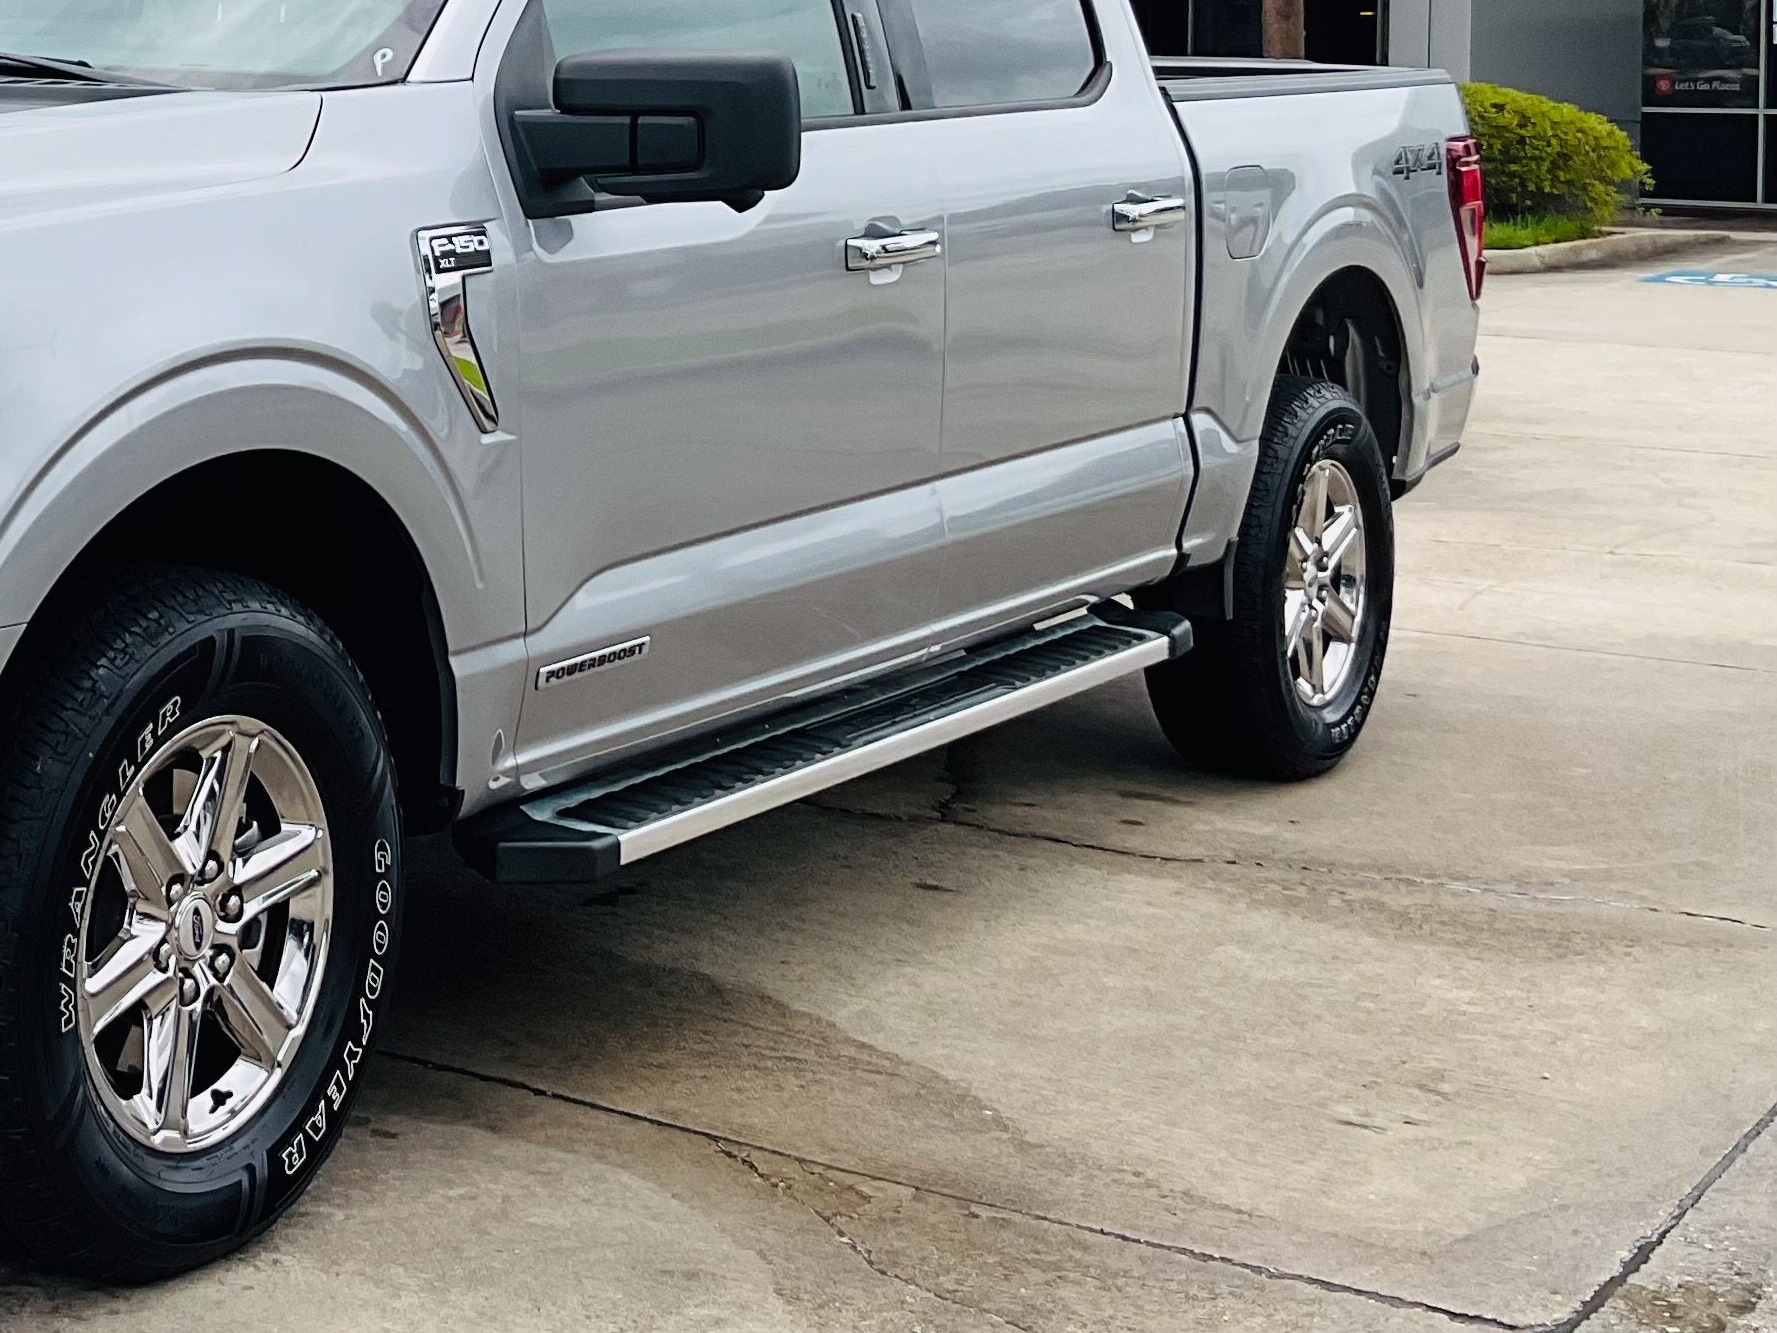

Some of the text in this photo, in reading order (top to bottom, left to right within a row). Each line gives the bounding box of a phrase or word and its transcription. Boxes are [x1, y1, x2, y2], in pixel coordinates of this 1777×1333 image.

[1674, 80, 1695, 90] Let's
[1696, 80, 1710, 90] Go
[431, 235, 489, 256] F-150
[439, 258, 455, 268] XLT
[544, 642, 646, 684] POWERBOOST
[59, 694, 181, 1034] WRANGLER
[280, 838, 392, 1178] GOODYEAR
